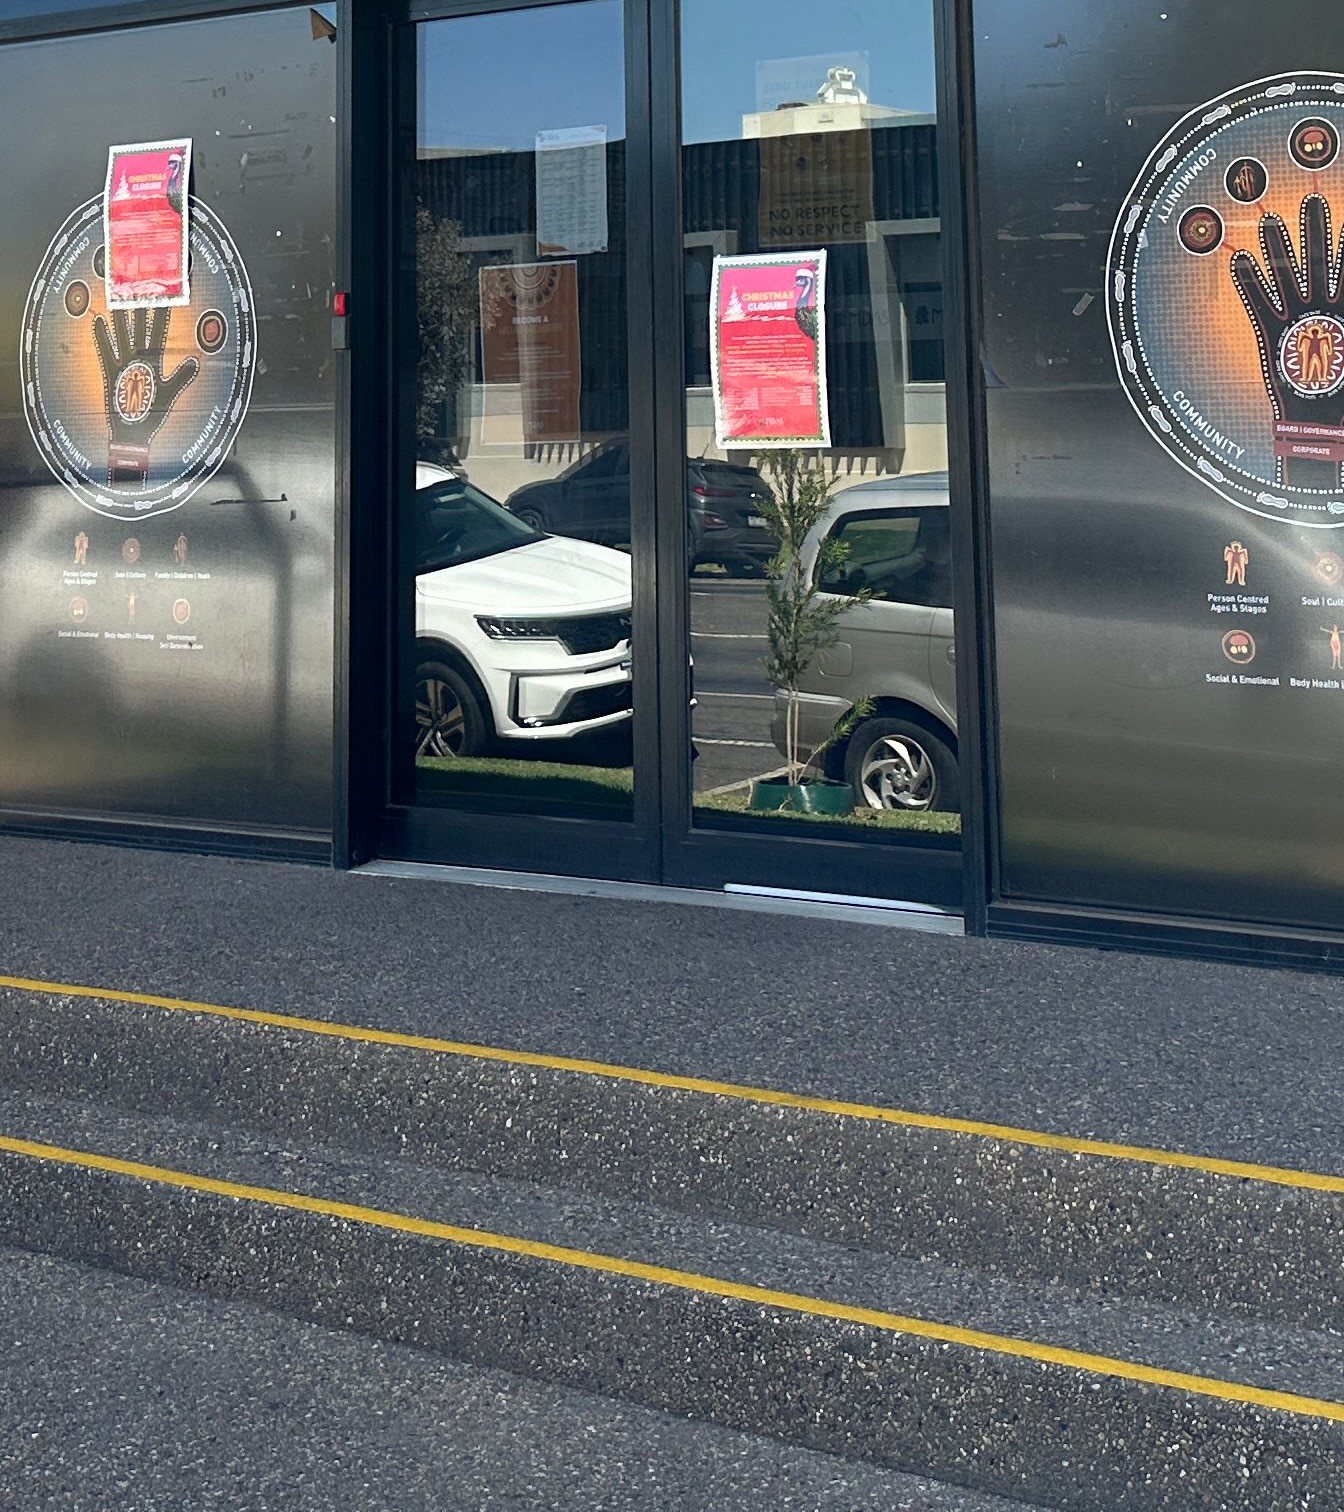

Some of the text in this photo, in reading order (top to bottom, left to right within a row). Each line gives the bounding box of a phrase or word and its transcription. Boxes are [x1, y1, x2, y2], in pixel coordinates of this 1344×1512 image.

[1157, 148, 1217, 225] COMMUNITY
[768, 221, 862, 238] NO SERVICE
[769, 204, 861, 221] NO RESPECT
[53, 237, 89, 294] COMMUNITY
[189, 231, 219, 274] COMMUN
[742, 290, 795, 302] CHRISTMAS
[747, 299, 788, 312] CLOSURE
[53, 419, 93, 471] COMMUNITY
[182, 404, 222, 464] COMMUNITY
[1173, 390, 1246, 460] COMMUNITY
[1207, 593, 1236, 603] Person
